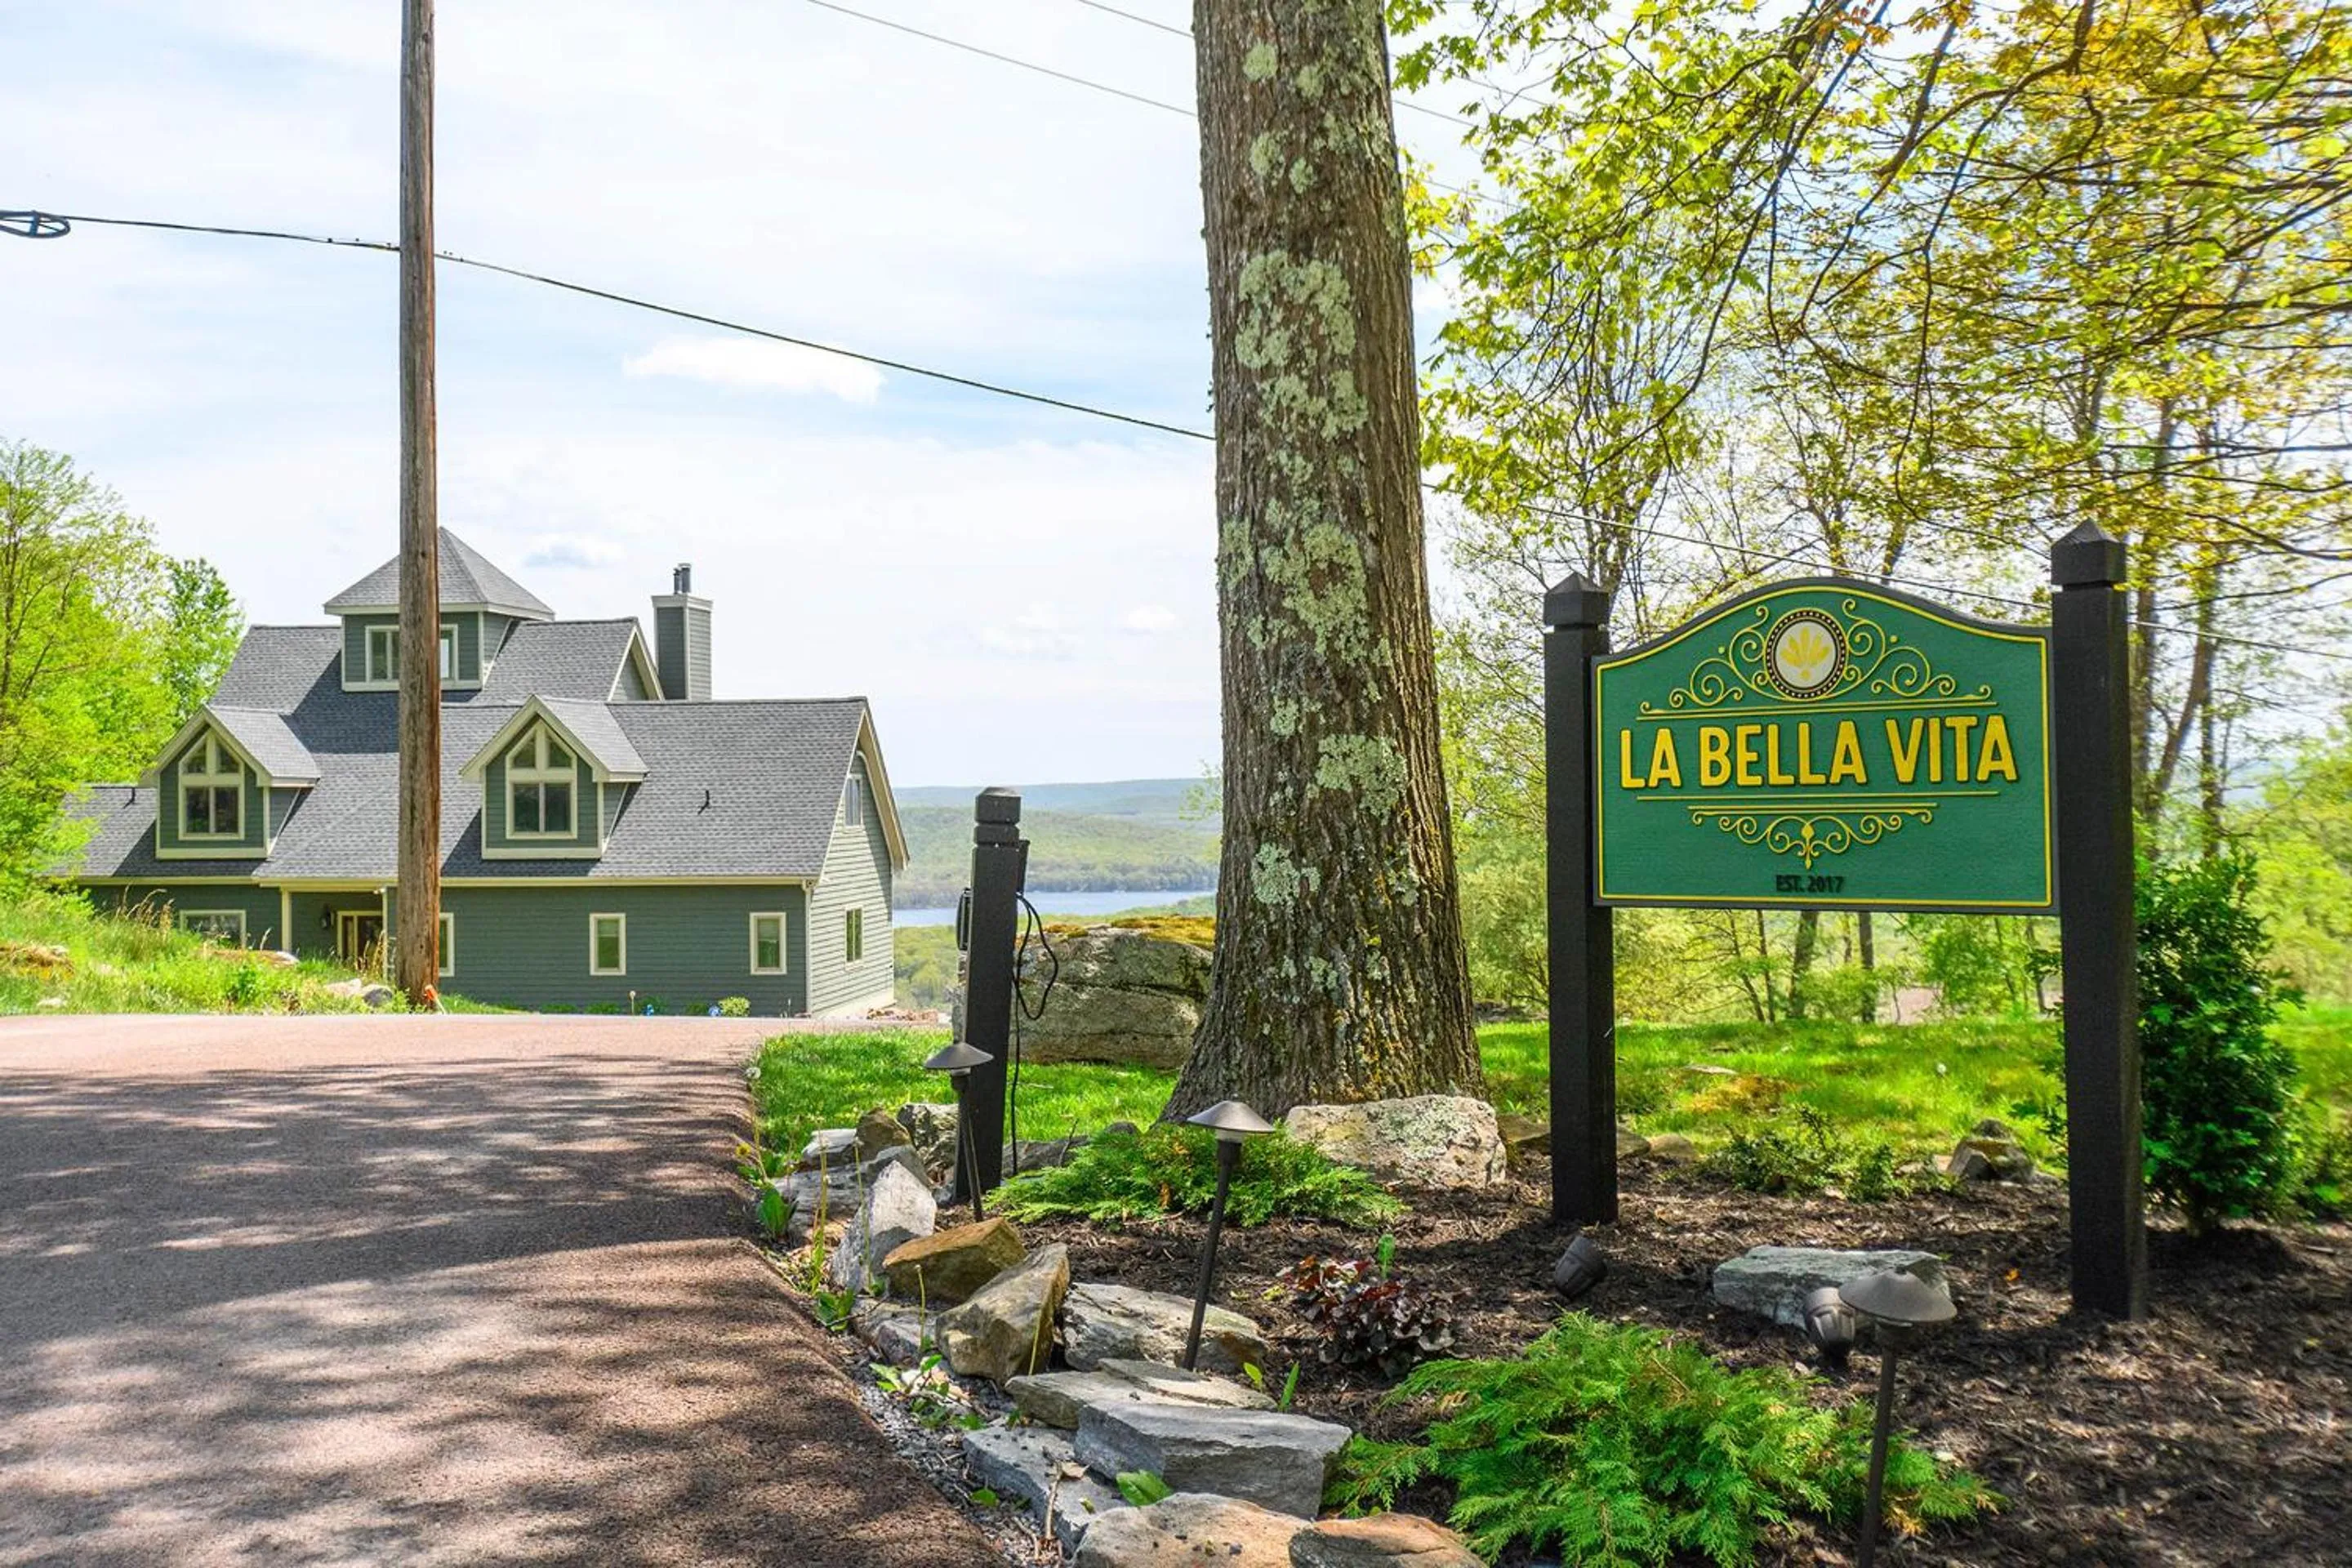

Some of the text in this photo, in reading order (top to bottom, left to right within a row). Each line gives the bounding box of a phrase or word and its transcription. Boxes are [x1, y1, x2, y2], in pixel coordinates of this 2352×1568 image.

[1620, 715, 2019, 788] LA BELLA VITA
[1775, 875, 1844, 893] EST. 2017
